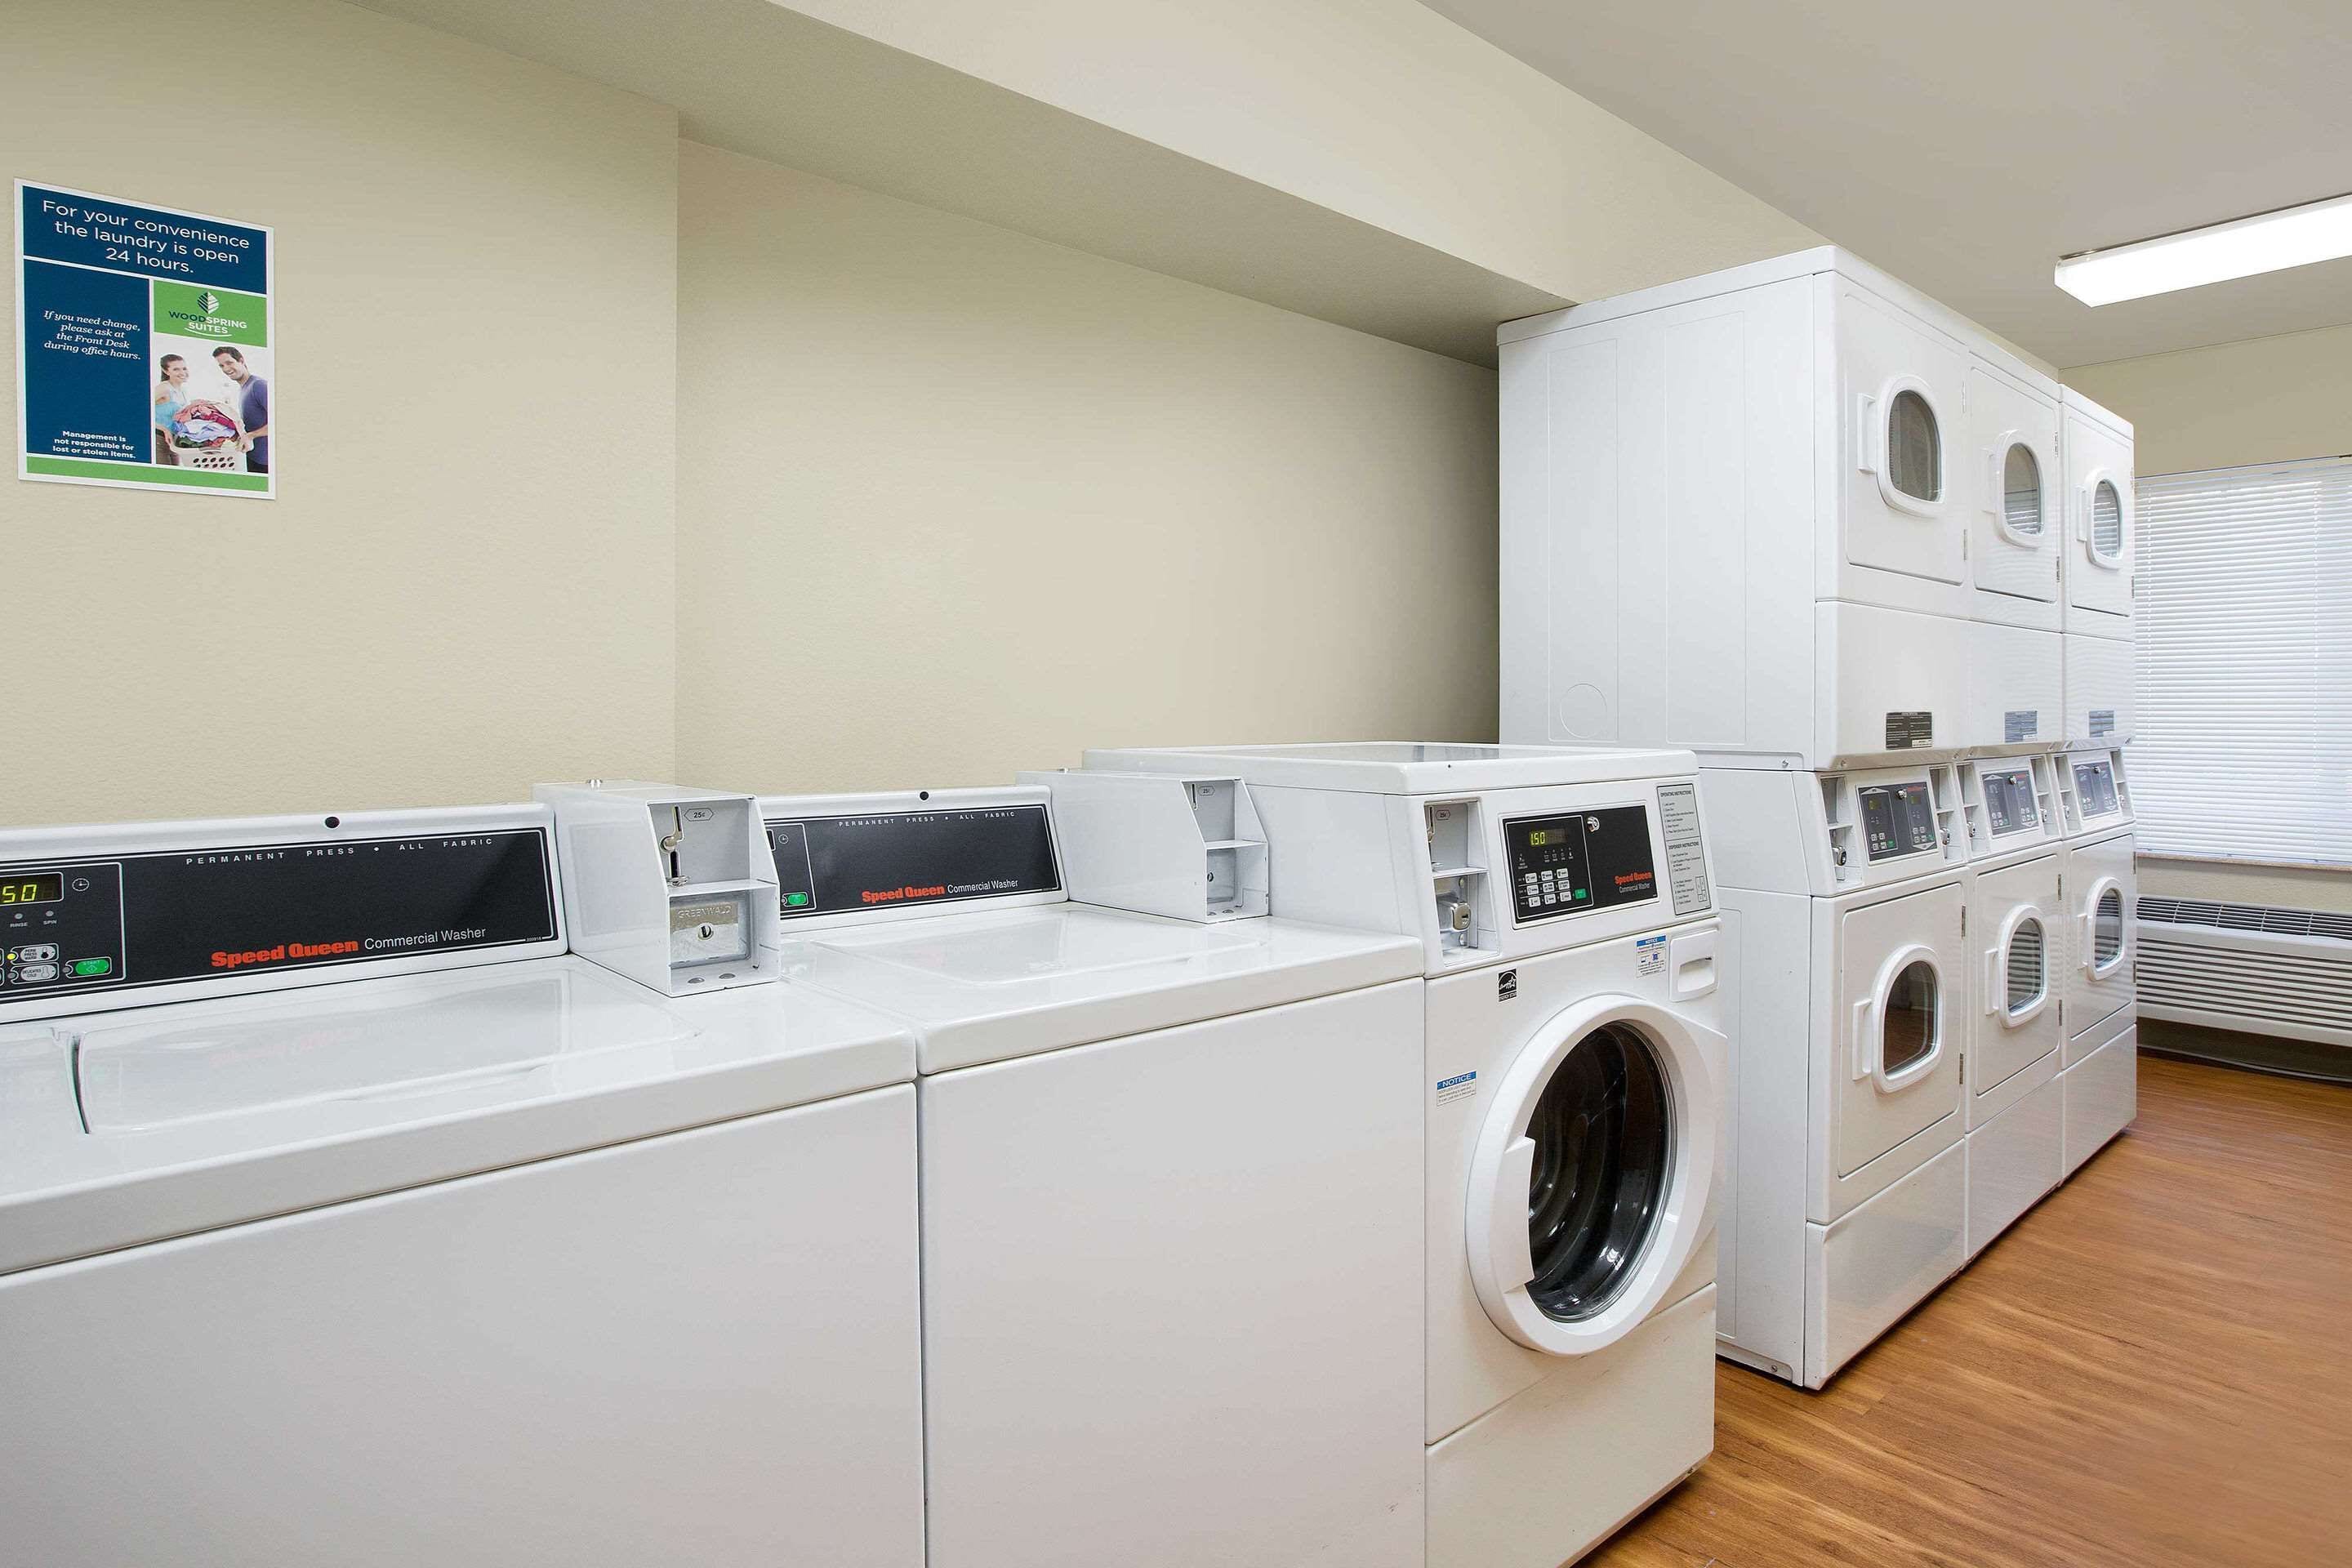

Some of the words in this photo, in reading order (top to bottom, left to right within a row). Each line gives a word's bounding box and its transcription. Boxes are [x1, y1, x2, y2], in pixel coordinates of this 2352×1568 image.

[42, 199, 78, 217] For
[83, 209, 128, 227] your
[135, 220, 250, 249] convenience
[55, 220, 88, 237] the
[95, 227, 167, 253] laundry
[174, 241, 188, 255] is
[194, 247, 239, 264] open
[105, 247, 131, 262] 24
[136, 252, 194, 273] hours.
[43, 310, 55, 319] If
[76, 315, 100, 325] need
[168, 310, 247, 329] WOODSPRING
[60, 323, 93, 334] please
[95, 328, 113, 336] ask
[188, 322, 229, 334] SUITES
[56, 332, 73, 341] the
[75, 334, 104, 345] Front
[105, 339, 130, 349] Desk
[44, 341, 79, 354] during
[82, 346, 108, 355] office
[109, 349, 141, 360] hours.
[62, 430, 117, 442] Management
[71, 439, 120, 450] responsible
[110, 450, 136, 458] items.
[839, 818, 895, 827] PERMANENT
[186, 852, 286, 865] PERMANENT
[306, 847, 355, 857] PRESS
[399, 843, 425, 851] ALL
[443, 838, 492, 848] FABRIC
[1615, 873, 1633, 885] Speed
[862, 888, 903, 904] Speed
[905, 885, 945, 899] Queen
[947, 881, 991, 894] Commercial
[991, 879, 1018, 889] Washer
[678, 905, 732, 919] GREENWALD
[211, 945, 284, 968] Speed
[288, 940, 359, 959] Queen
[364, 931, 439, 951] Commercial
[441, 927, 486, 942] Washer
[1441, 1074, 1472, 1087] NOTICE
